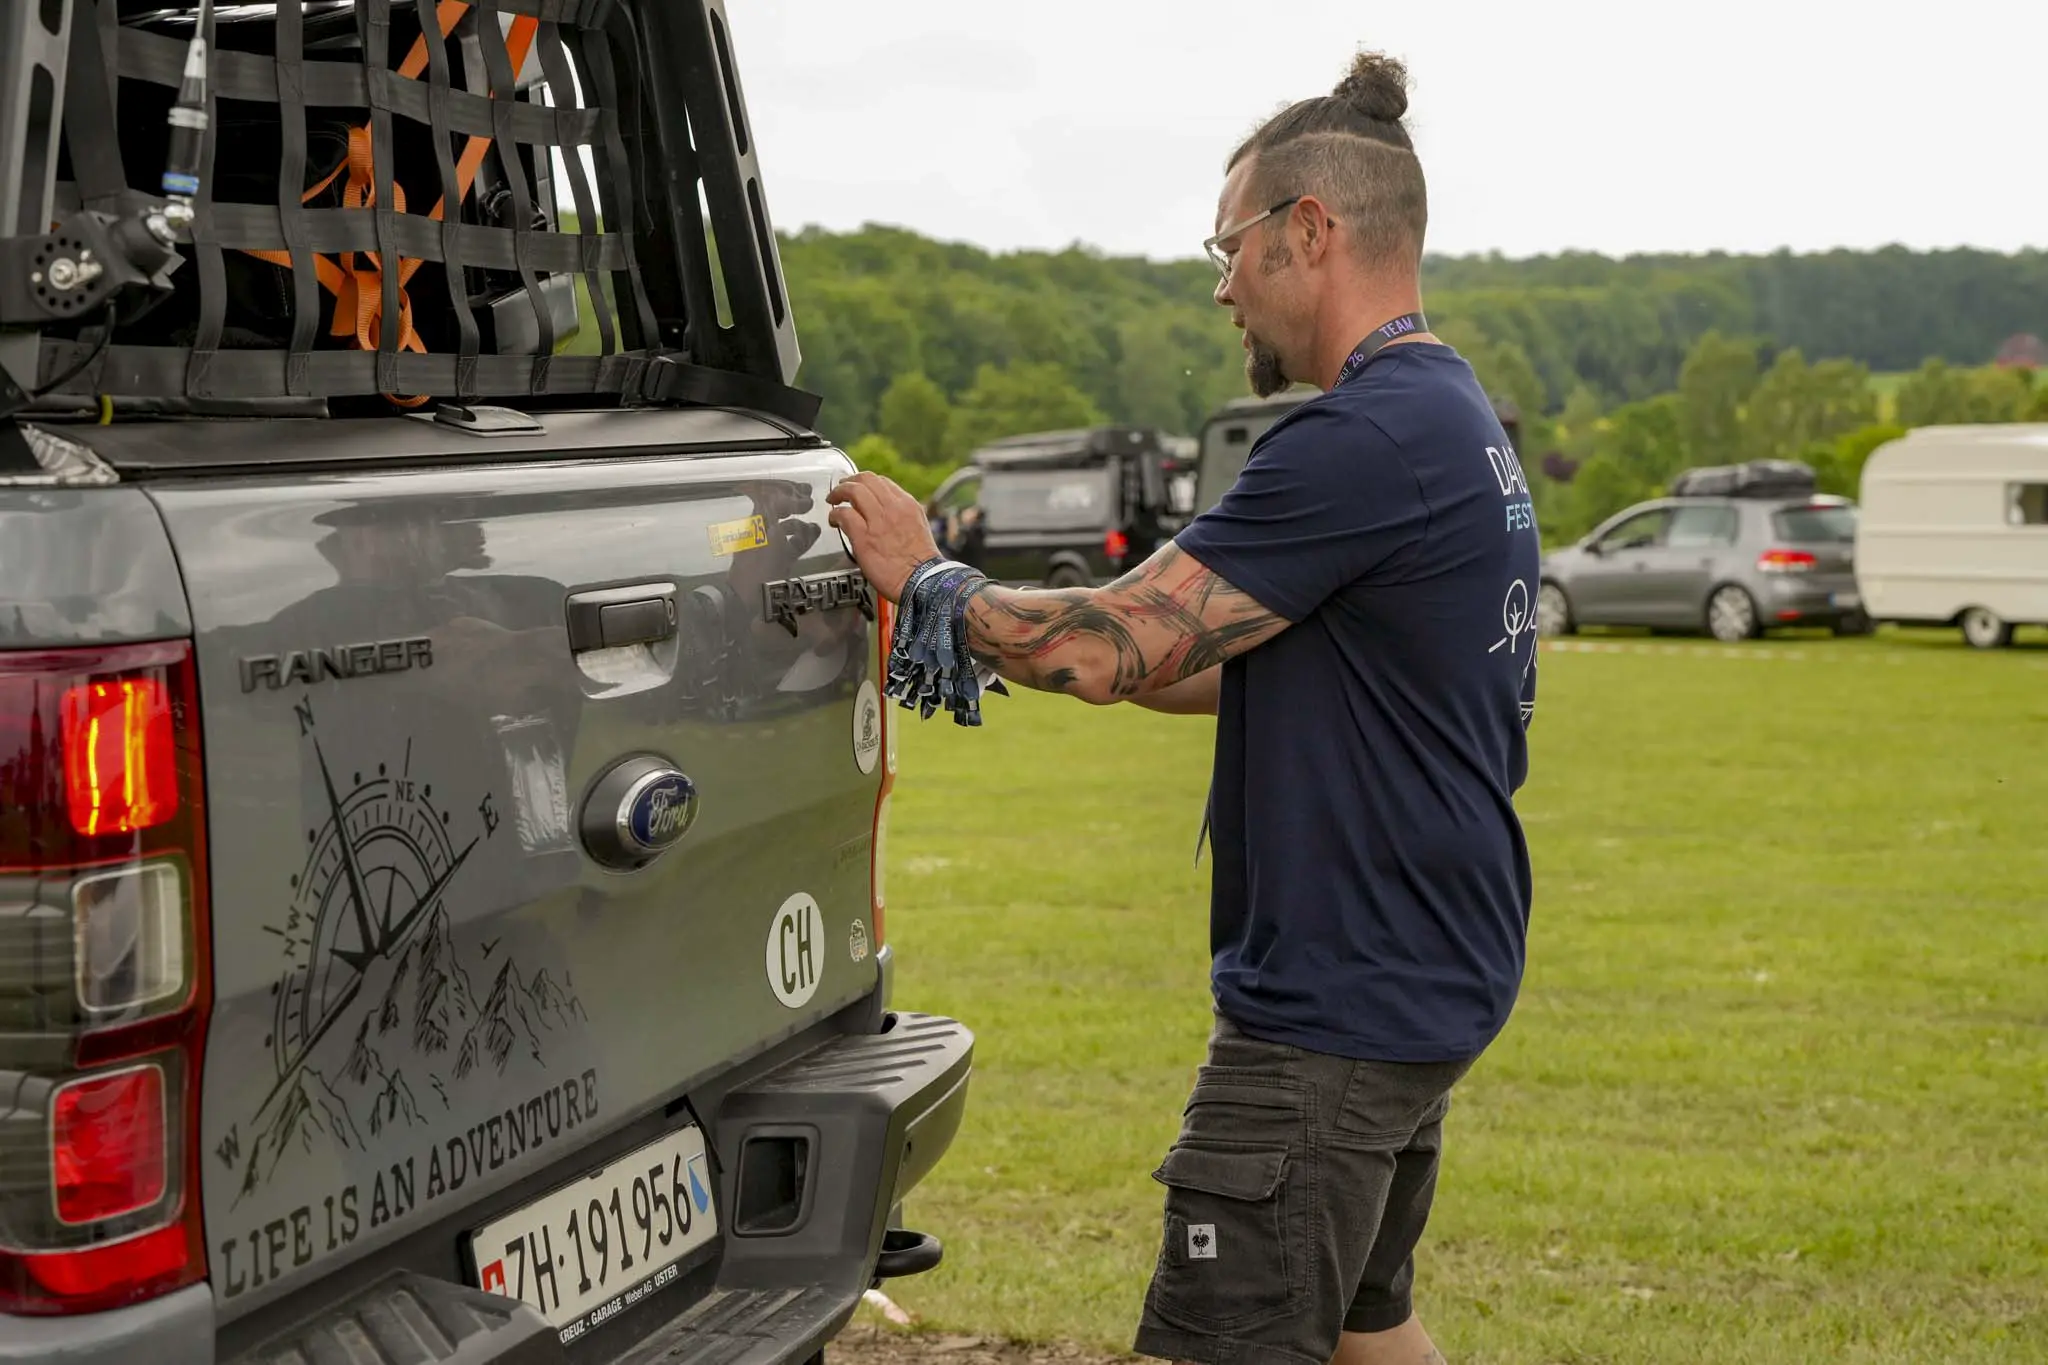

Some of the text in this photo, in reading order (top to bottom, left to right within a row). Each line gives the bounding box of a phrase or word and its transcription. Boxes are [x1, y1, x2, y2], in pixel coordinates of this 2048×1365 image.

[1348, 351, 1365, 369] 26
[1379, 316, 1416, 339] TEAM
[762, 568, 875, 638] RAPTOR
[943, 616, 952, 650] DACHZELT
[239, 636, 433, 693] RANGER
[294, 693, 315, 736] N
[395, 779, 416, 803] NE
[479, 792, 500, 839] E
[648, 785, 690, 836] Ford
[780, 905, 814, 994] CH
[215, 1123, 241, 1170] W
[221, 1068, 599, 1299] LIFE IS AN ADVENTURE
[590, 1298, 622, 1326] GARAGE
[624, 1286, 643, 1305] Weber
[643, 1280, 653, 1294] AG
[654, 1263, 678, 1287] USTER
